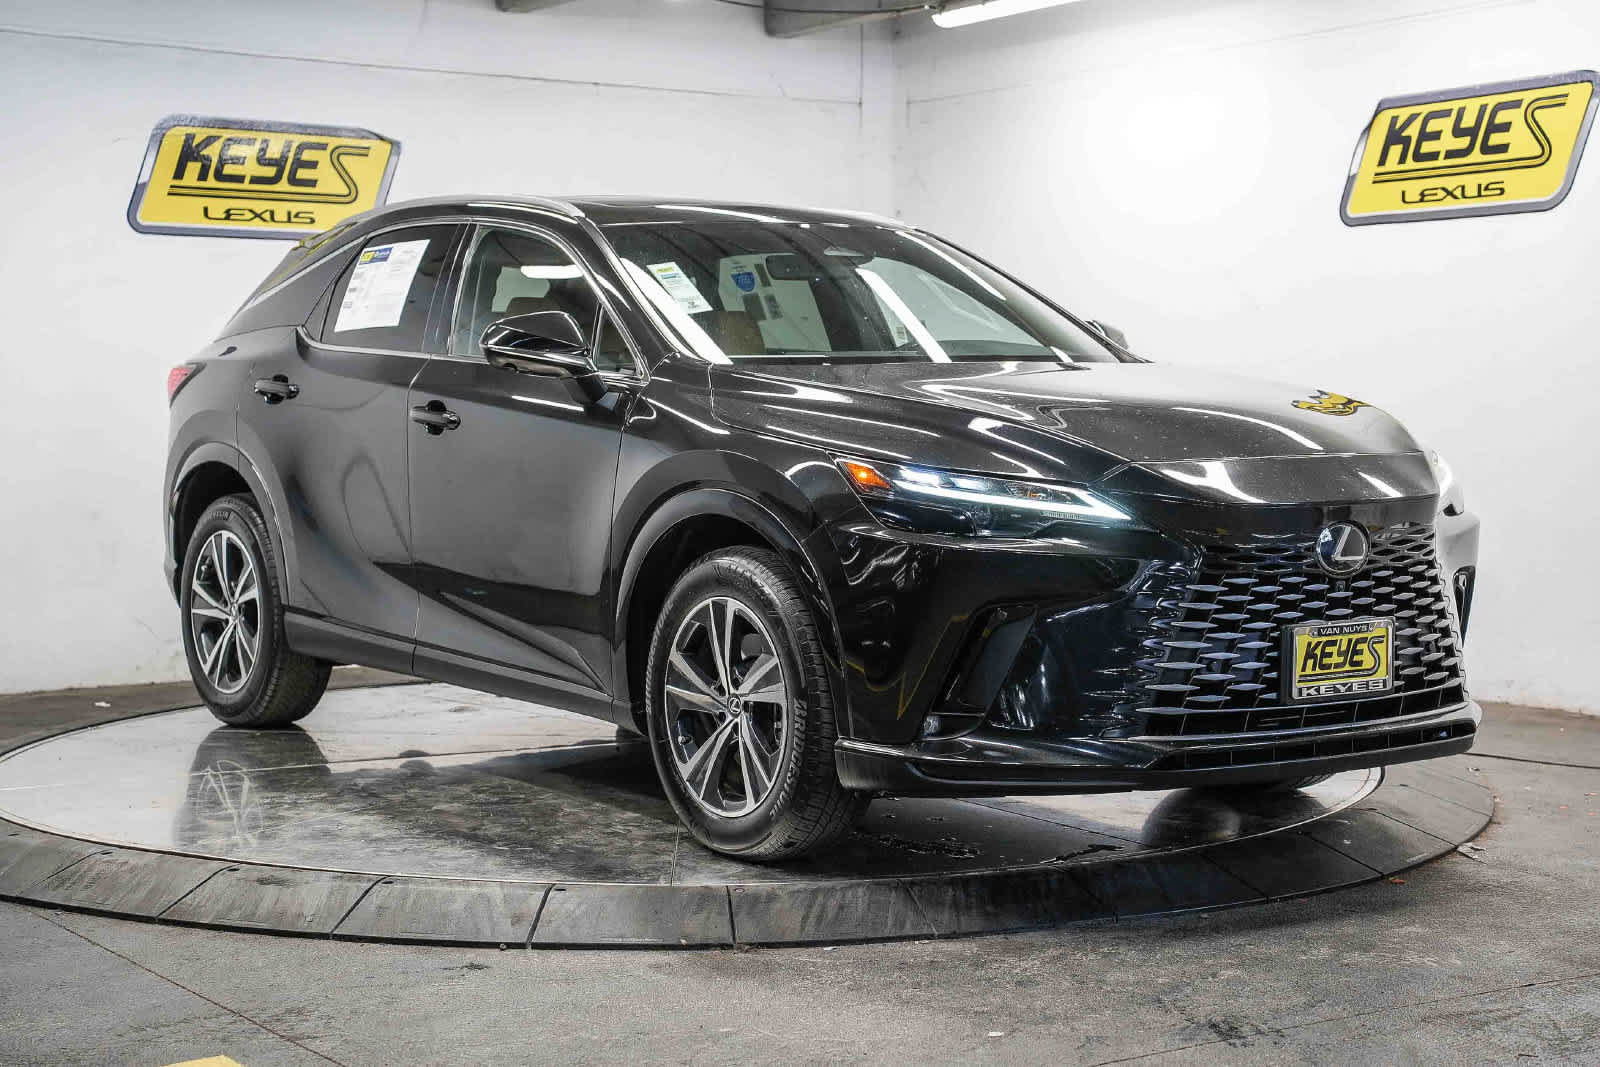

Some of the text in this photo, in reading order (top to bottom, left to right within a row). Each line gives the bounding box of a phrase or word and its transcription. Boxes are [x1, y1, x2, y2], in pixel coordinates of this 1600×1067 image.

[1372, 93, 1569, 184] KEYES
[168, 133, 371, 204] KEYES
[1401, 181, 1505, 204] LEXUS
[203, 205, 316, 224] LEXUS
[1320, 625, 1368, 635] VAN NUYS
[1298, 635, 1385, 683] KEYES
[1301, 680, 1384, 697] KEYES
